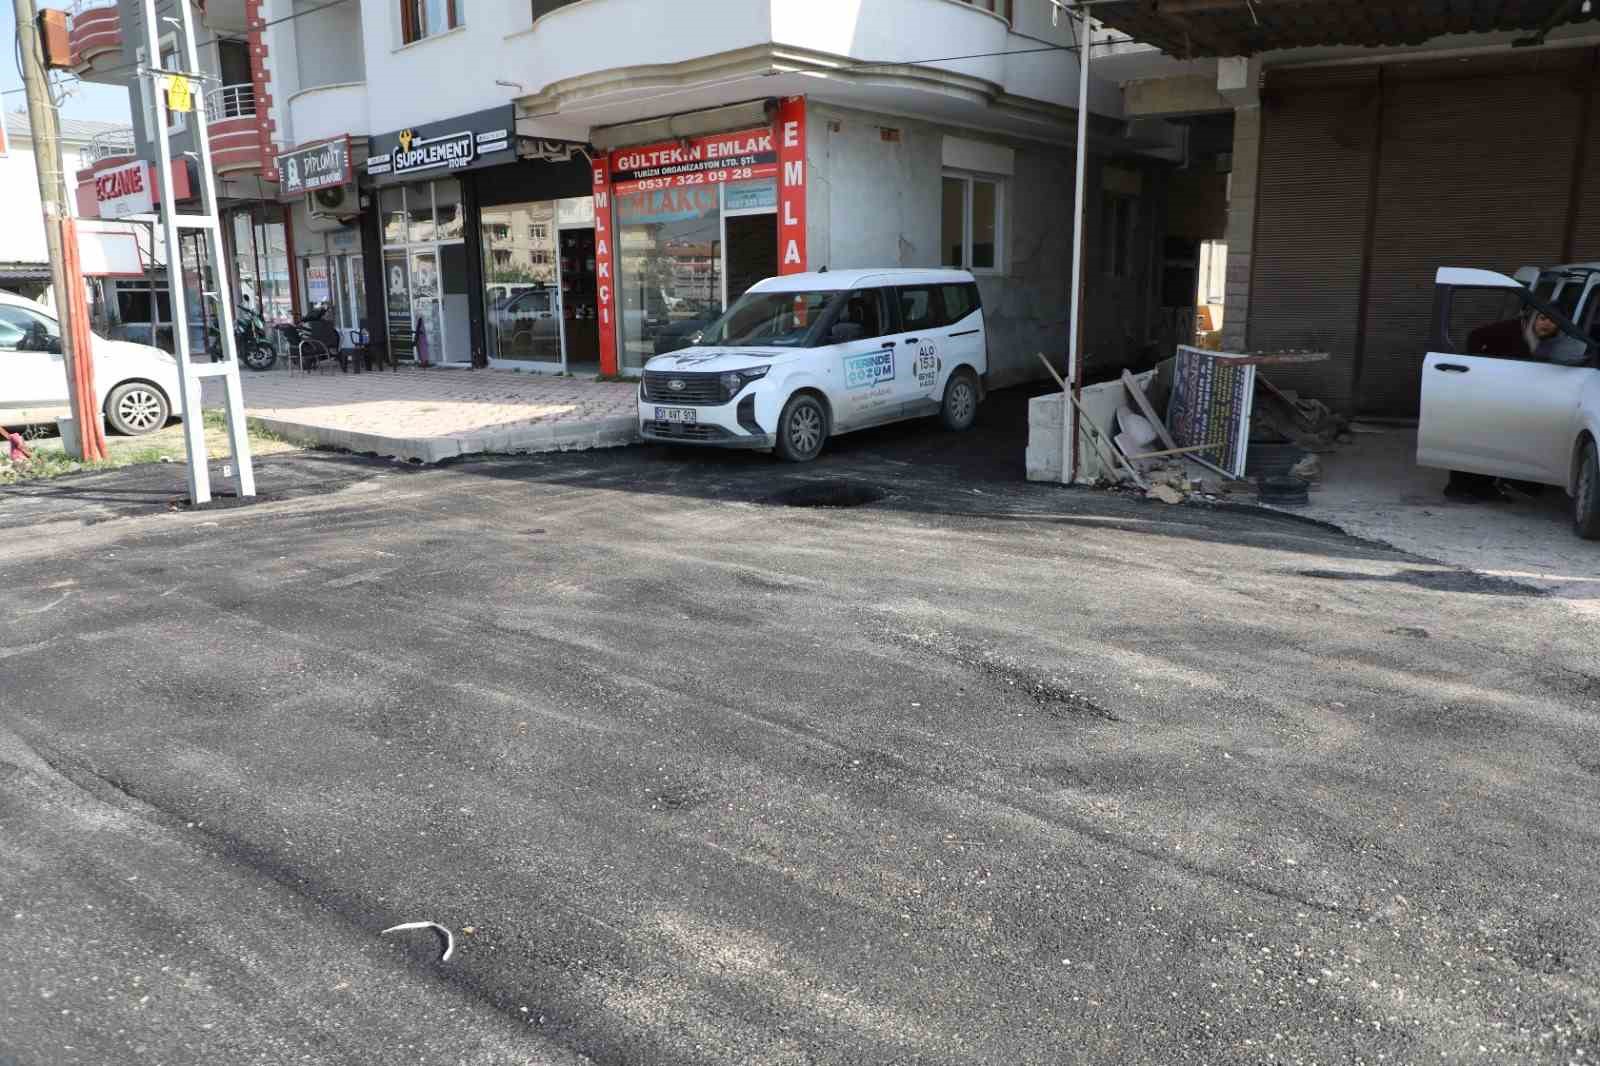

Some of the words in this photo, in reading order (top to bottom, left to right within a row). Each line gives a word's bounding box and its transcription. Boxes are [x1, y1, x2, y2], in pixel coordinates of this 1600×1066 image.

[396, 140, 469, 169] SUPPLEMENT
[707, 136, 773, 158] EMLAK
[96, 166, 143, 202] ECZANE
[638, 177, 672, 190] 0537
[676, 173, 704, 186] 322
[708, 170, 727, 182] 09
[731, 167, 752, 180] 28
[594, 168, 609, 324] EMLAKÇI
[920, 345, 935, 357] ALO
[920, 357, 935, 370] 153
